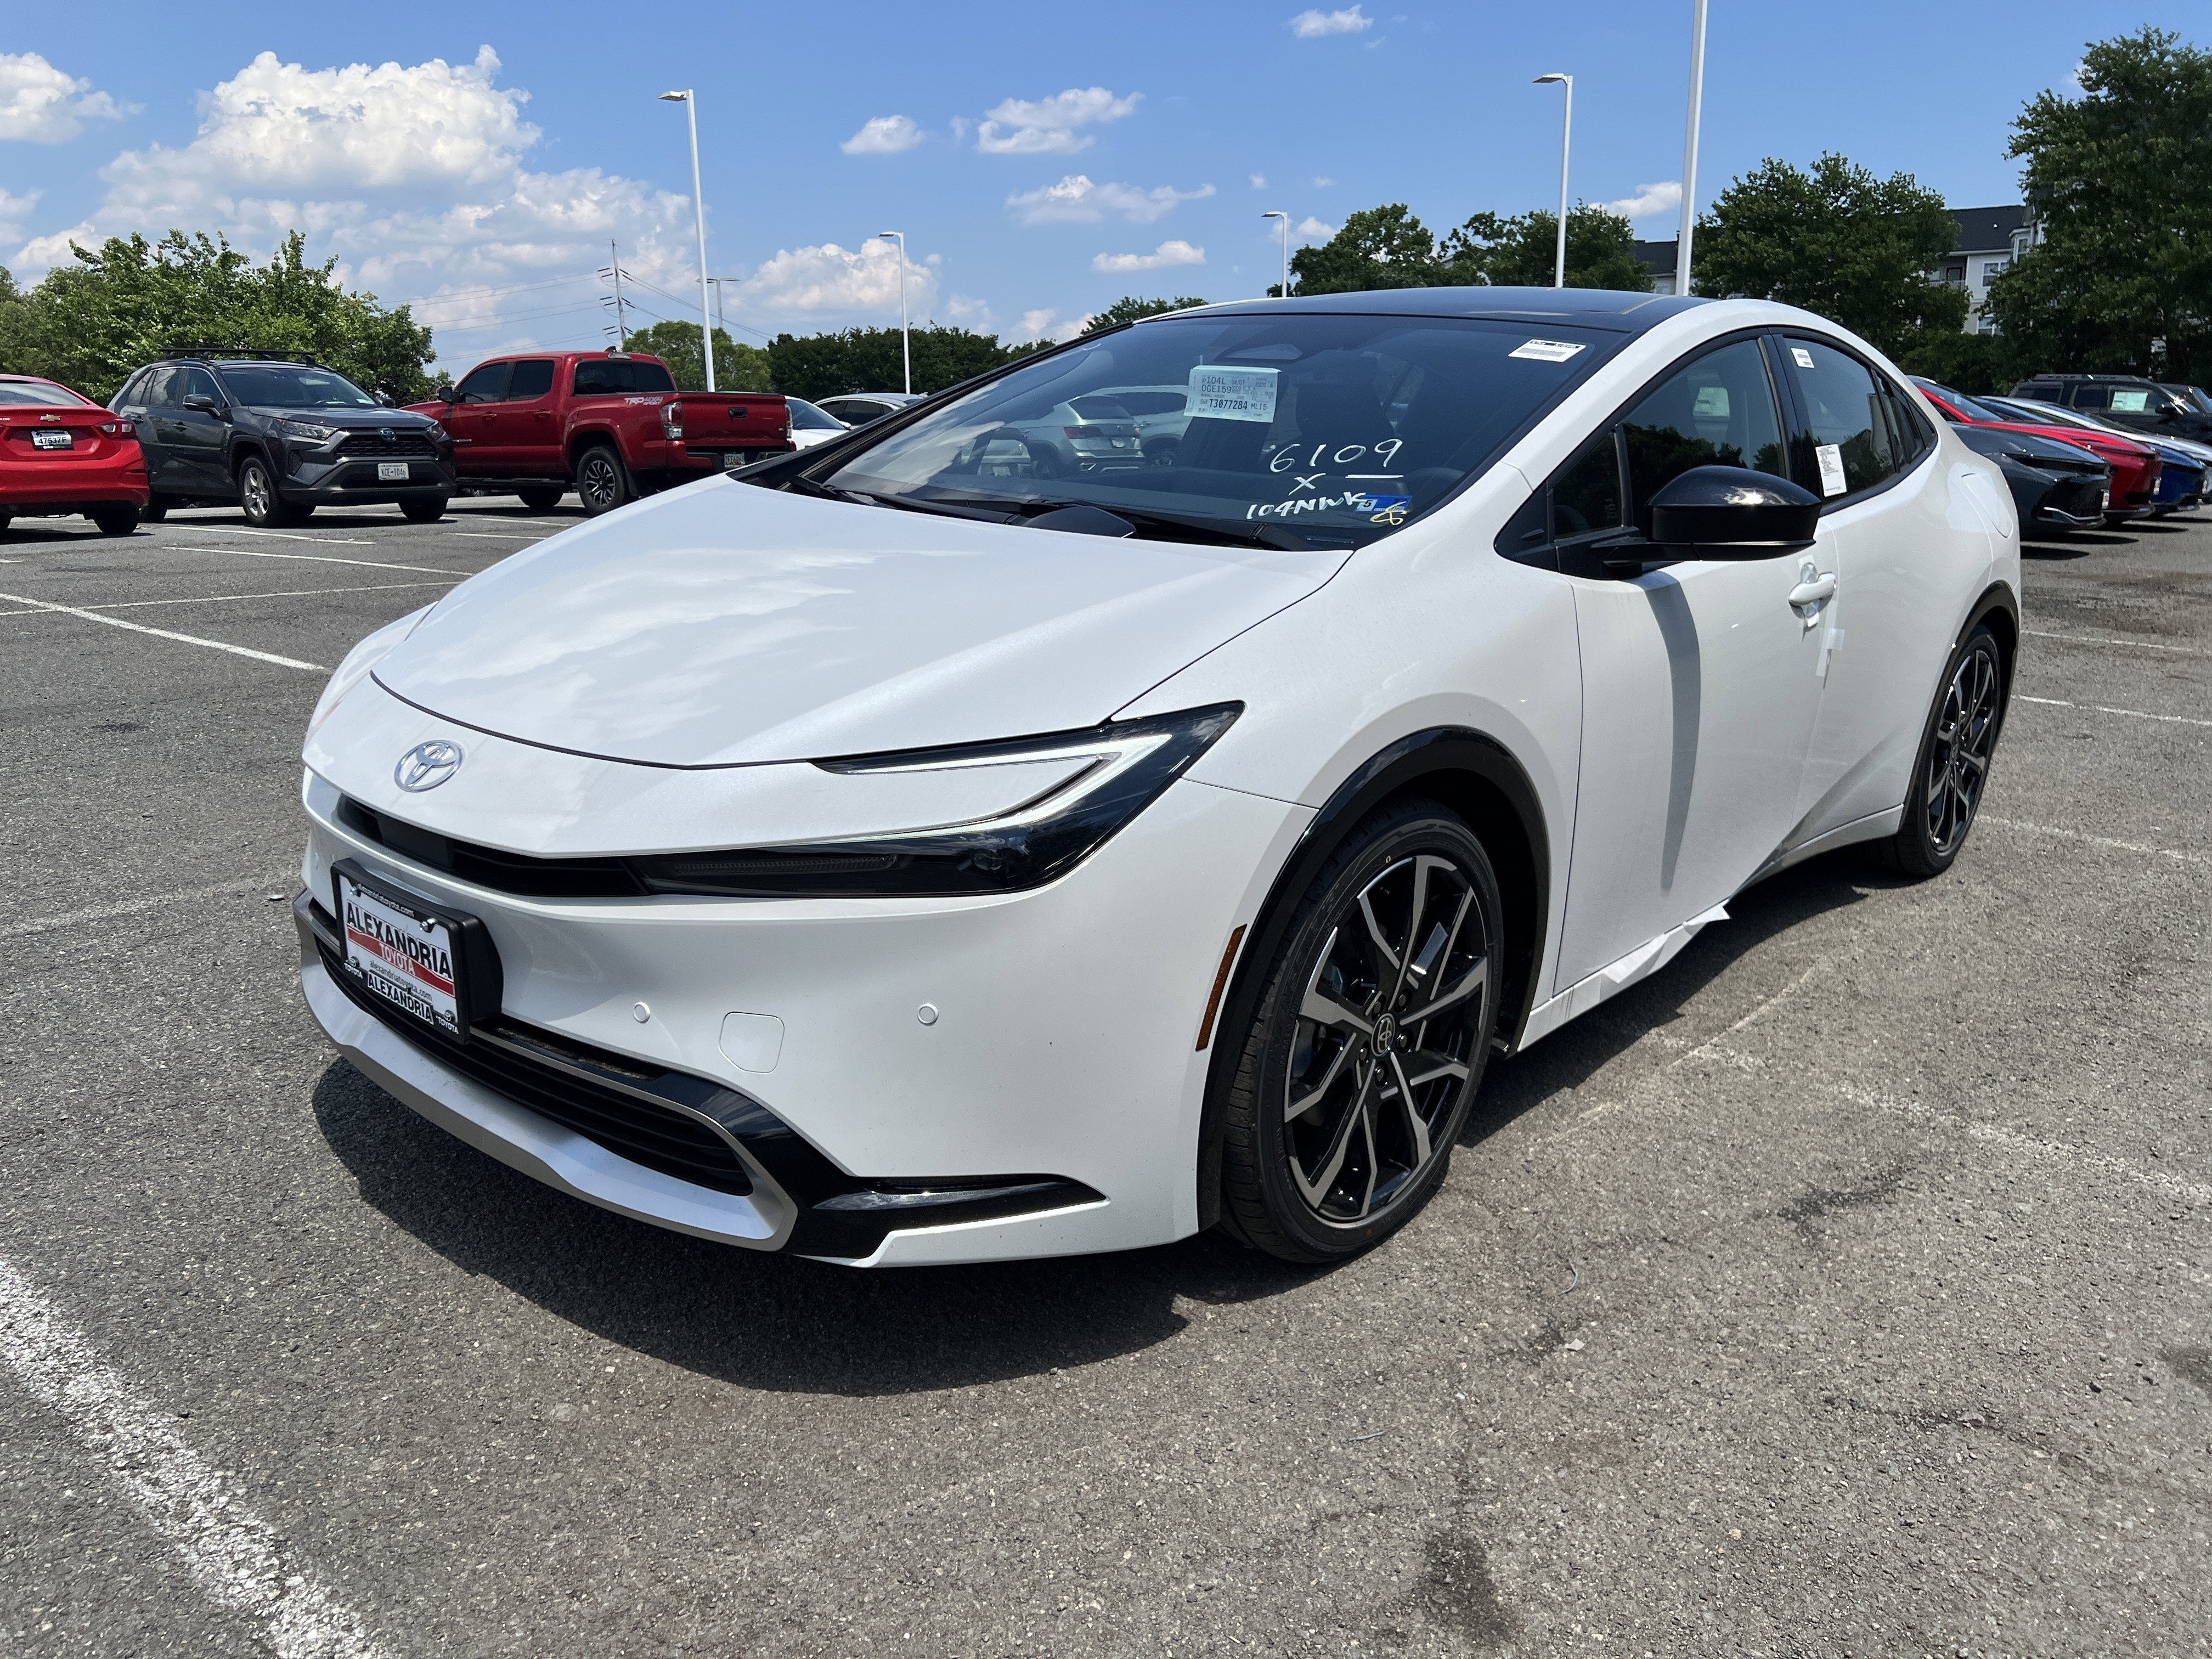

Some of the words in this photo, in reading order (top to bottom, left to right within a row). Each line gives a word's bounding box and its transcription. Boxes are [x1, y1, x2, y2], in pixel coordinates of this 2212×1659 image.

[624, 397, 644, 405] TRD
[1209, 398, 1248, 410] T3077284
[1269, 438, 1403, 472] 6109
[347, 901, 454, 980] ALEXANDRIA
[343, 962, 364, 979] TOYOTA
[379, 941, 416, 975] TOYOTA
[367, 971, 435, 1025] ALEXANDRIA
[436, 1015, 459, 1035] TOYOTA
